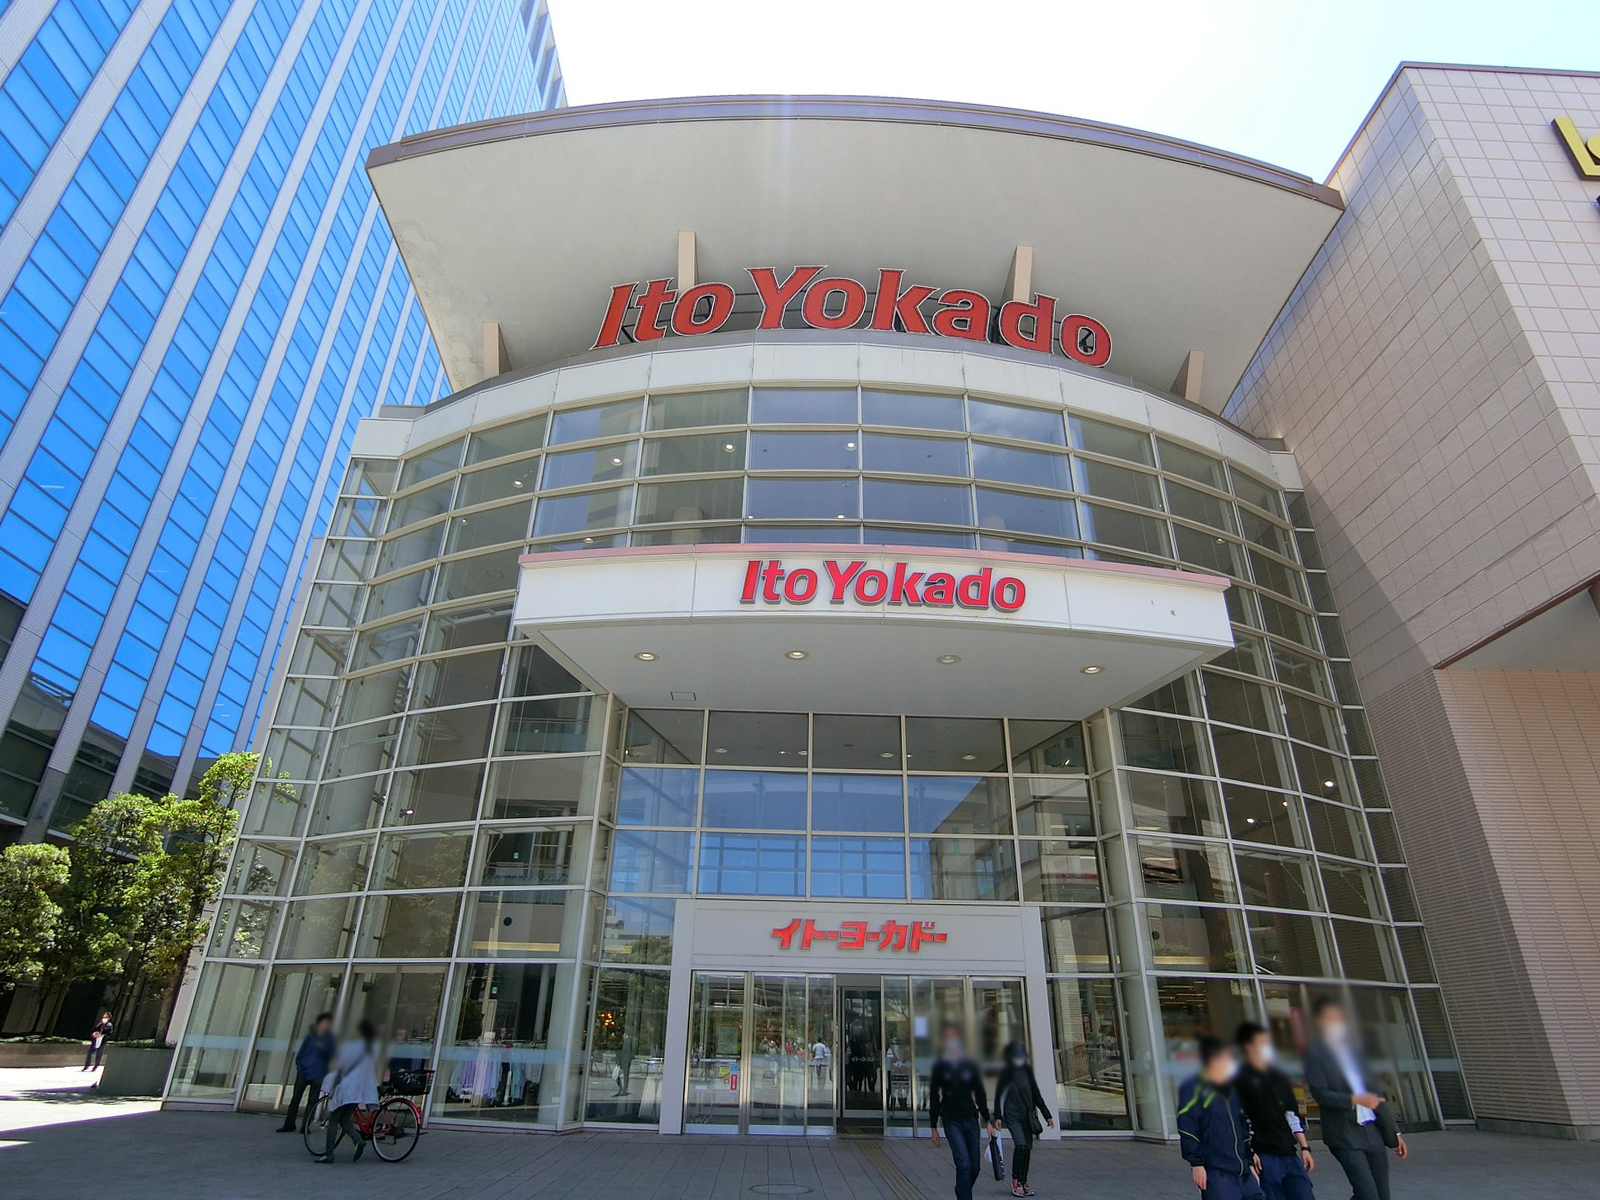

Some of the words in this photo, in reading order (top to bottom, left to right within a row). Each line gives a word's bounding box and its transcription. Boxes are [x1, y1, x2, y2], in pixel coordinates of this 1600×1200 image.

[590, 277, 736, 350] Ito
[744, 264, 1112, 367] Yokado
[771, 918, 948, 951] イトーヨーカドー
